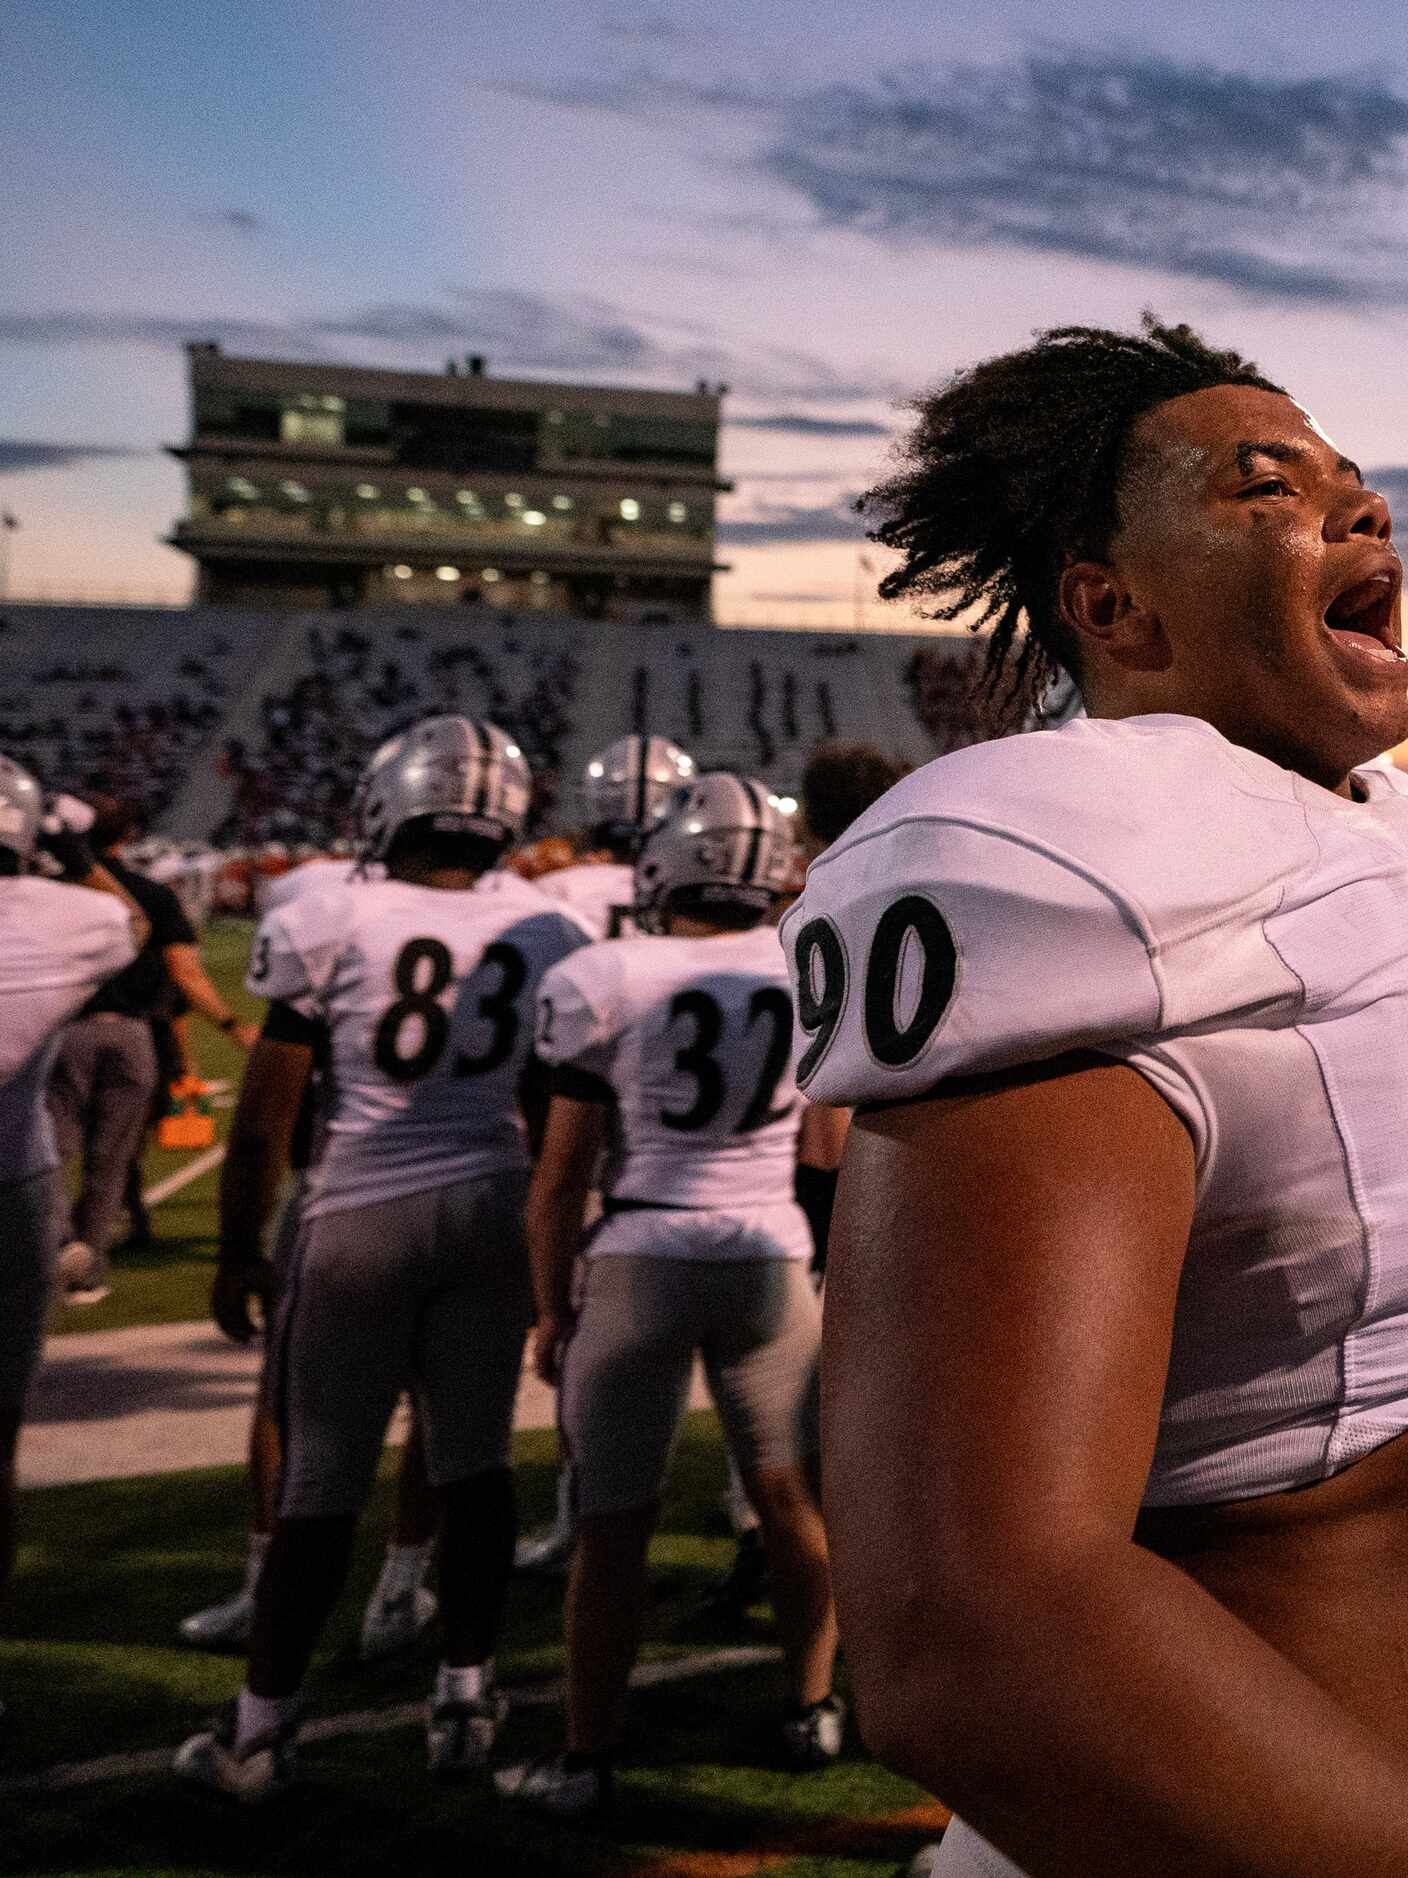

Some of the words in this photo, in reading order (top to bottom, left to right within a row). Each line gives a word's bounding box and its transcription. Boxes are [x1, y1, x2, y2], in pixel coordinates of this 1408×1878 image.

[374, 936, 528, 1082] 83
[658, 984, 794, 1134] 32
[795, 888, 964, 1092] 90
